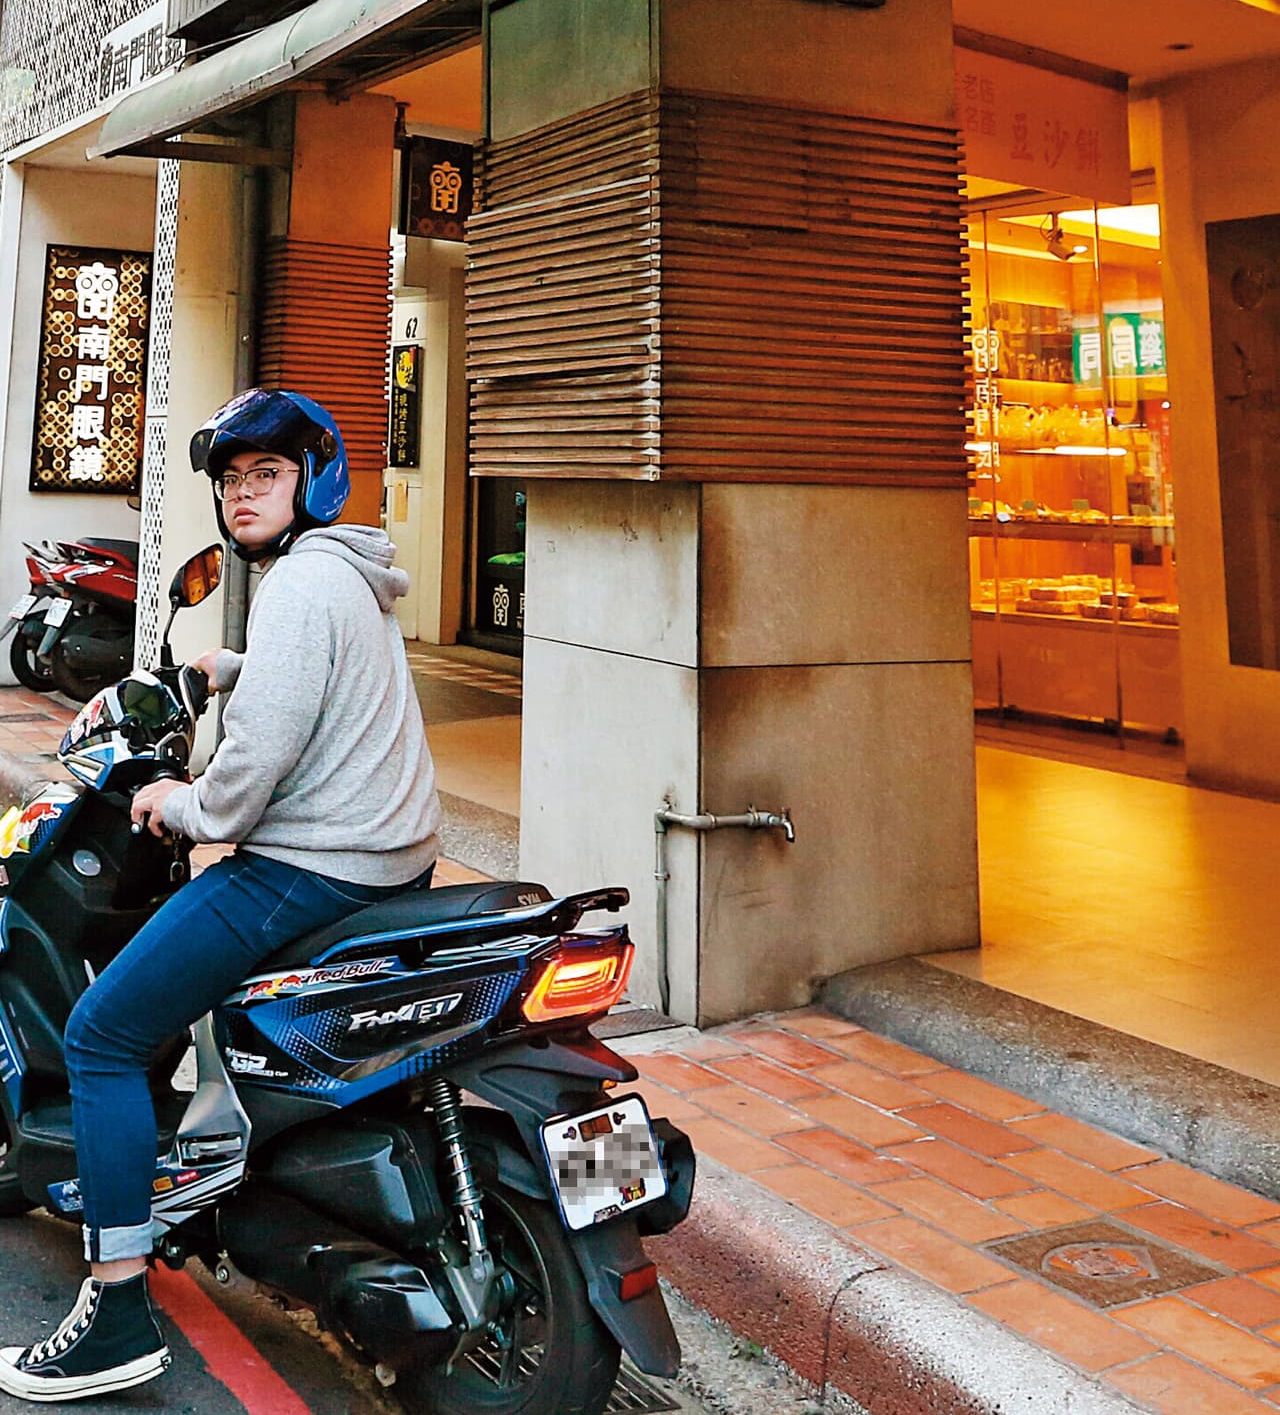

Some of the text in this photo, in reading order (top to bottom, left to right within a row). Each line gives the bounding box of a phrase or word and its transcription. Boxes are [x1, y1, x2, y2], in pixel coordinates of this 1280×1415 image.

[405, 316, 418, 339] 62
[68, 324, 112, 482] 南門眼鏡
